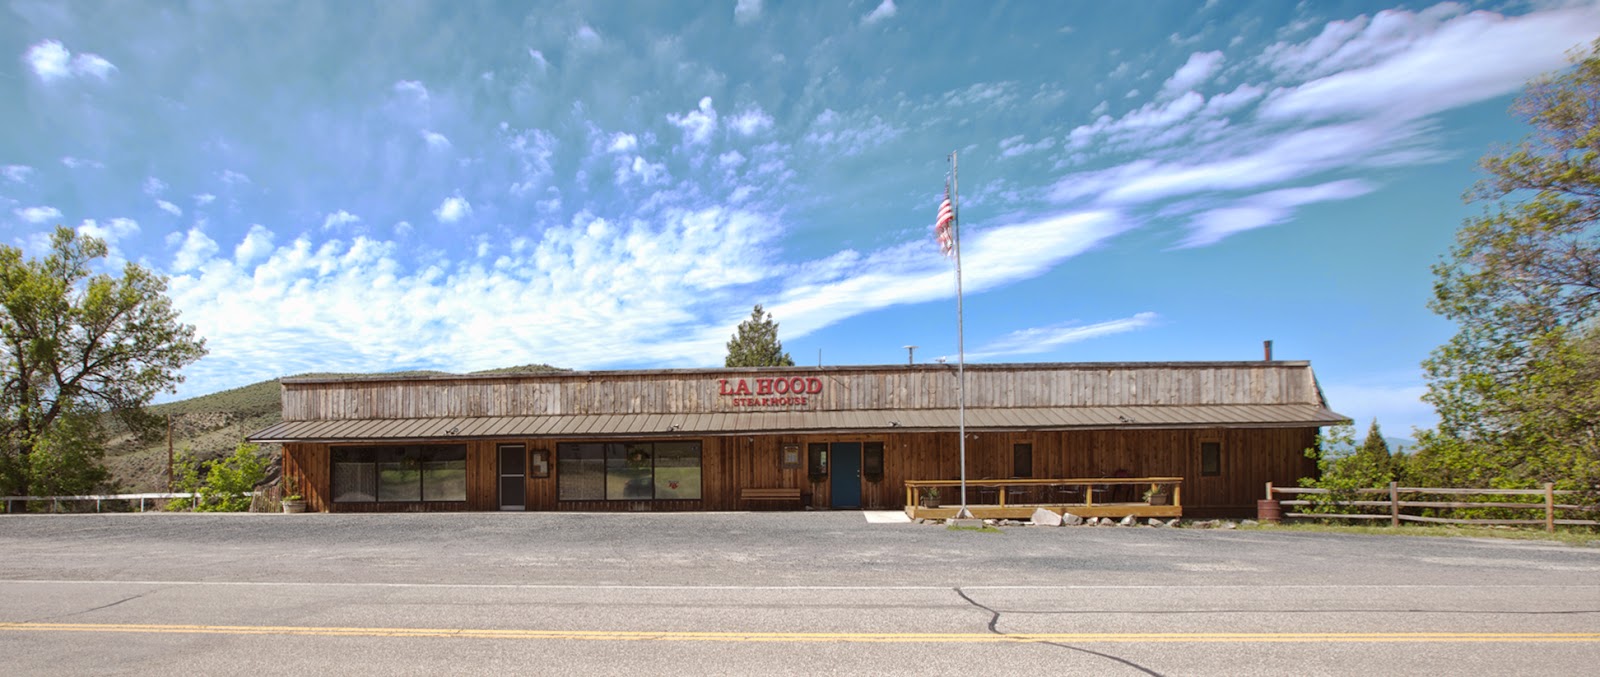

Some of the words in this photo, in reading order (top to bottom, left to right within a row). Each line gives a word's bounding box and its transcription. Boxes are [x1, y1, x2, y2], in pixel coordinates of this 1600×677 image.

[719, 379, 752, 395] LA
[756, 377, 823, 395] HOOD
[733, 397, 807, 407] STEAKHOUSE
